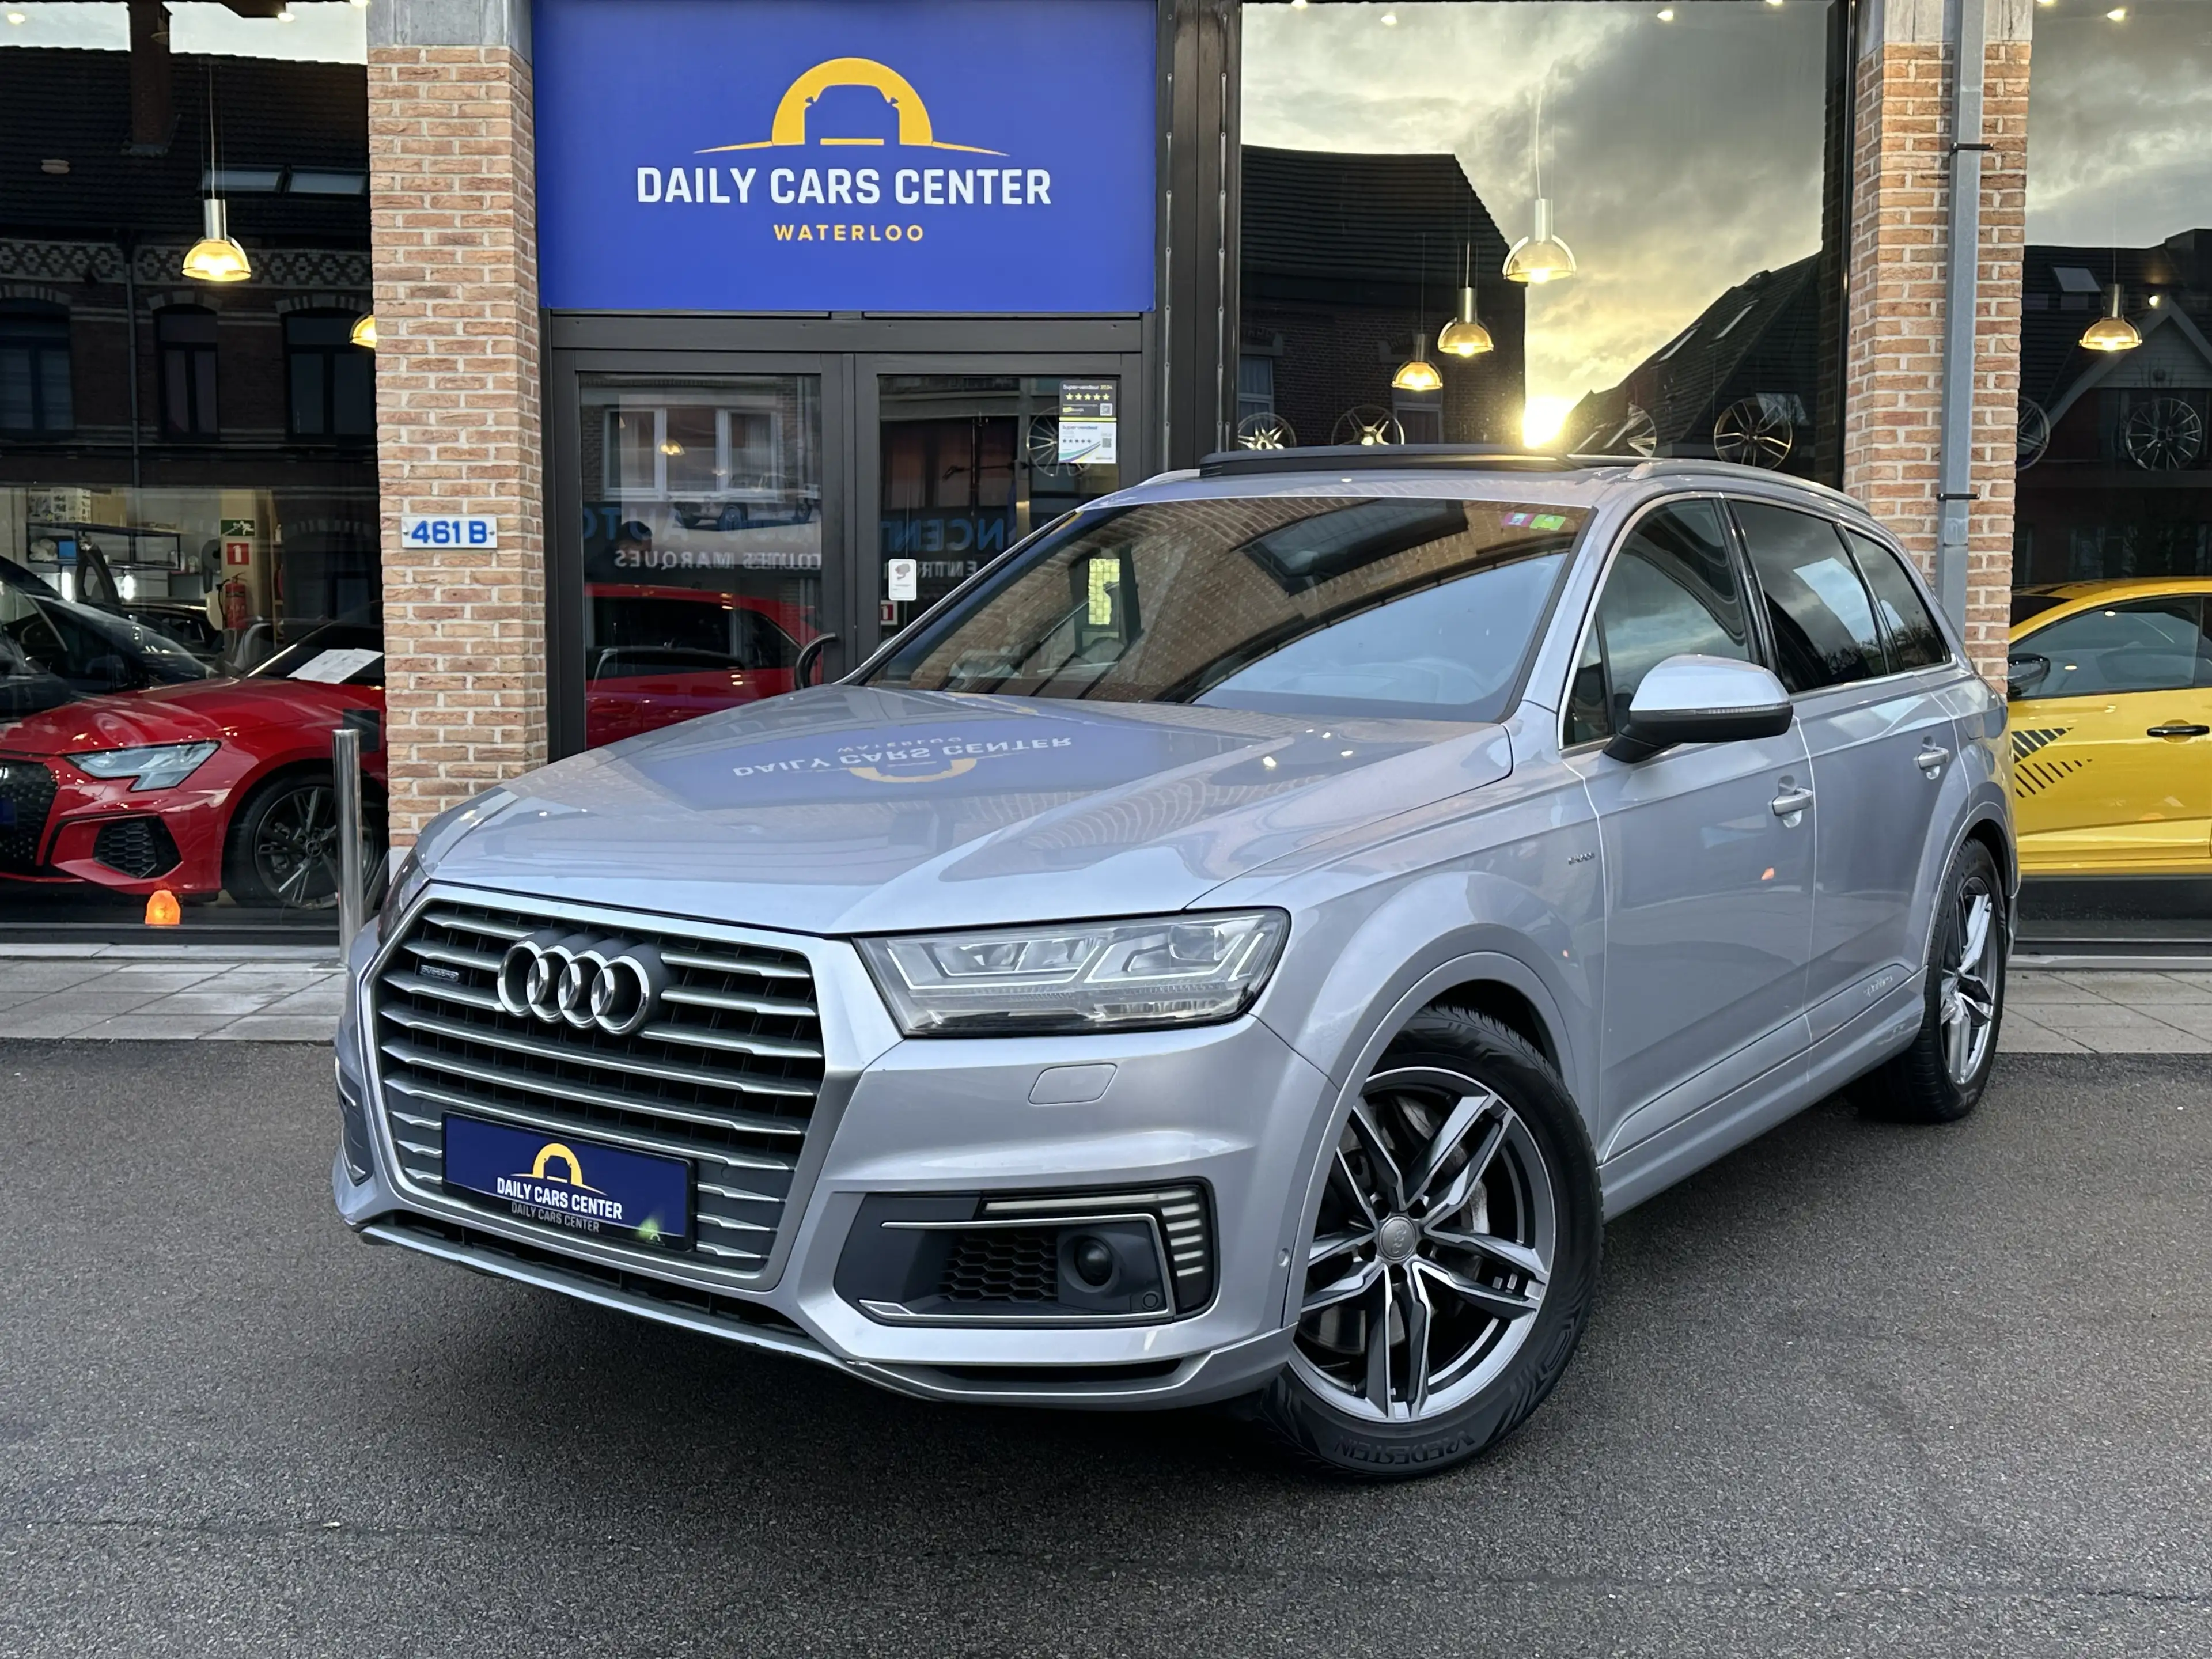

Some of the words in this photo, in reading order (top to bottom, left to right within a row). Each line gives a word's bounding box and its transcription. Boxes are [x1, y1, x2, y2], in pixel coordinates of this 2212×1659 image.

[637, 167, 756, 203] DAILY
[770, 168, 880, 204] CARS
[895, 168, 1051, 205] CENTER
[774, 224, 924, 242] WATERLOO
[411, 520, 460, 544] 461
[469, 520, 487, 544] B
[497, 1177, 532, 1200] DAILY
[534, 1185, 569, 1209] CARS
[571, 1194, 623, 1220] CENTER
[511, 1202, 537, 1219] DAILY
[537, 1209, 562, 1225] CARS
[564, 1215, 600, 1233] CENTER
